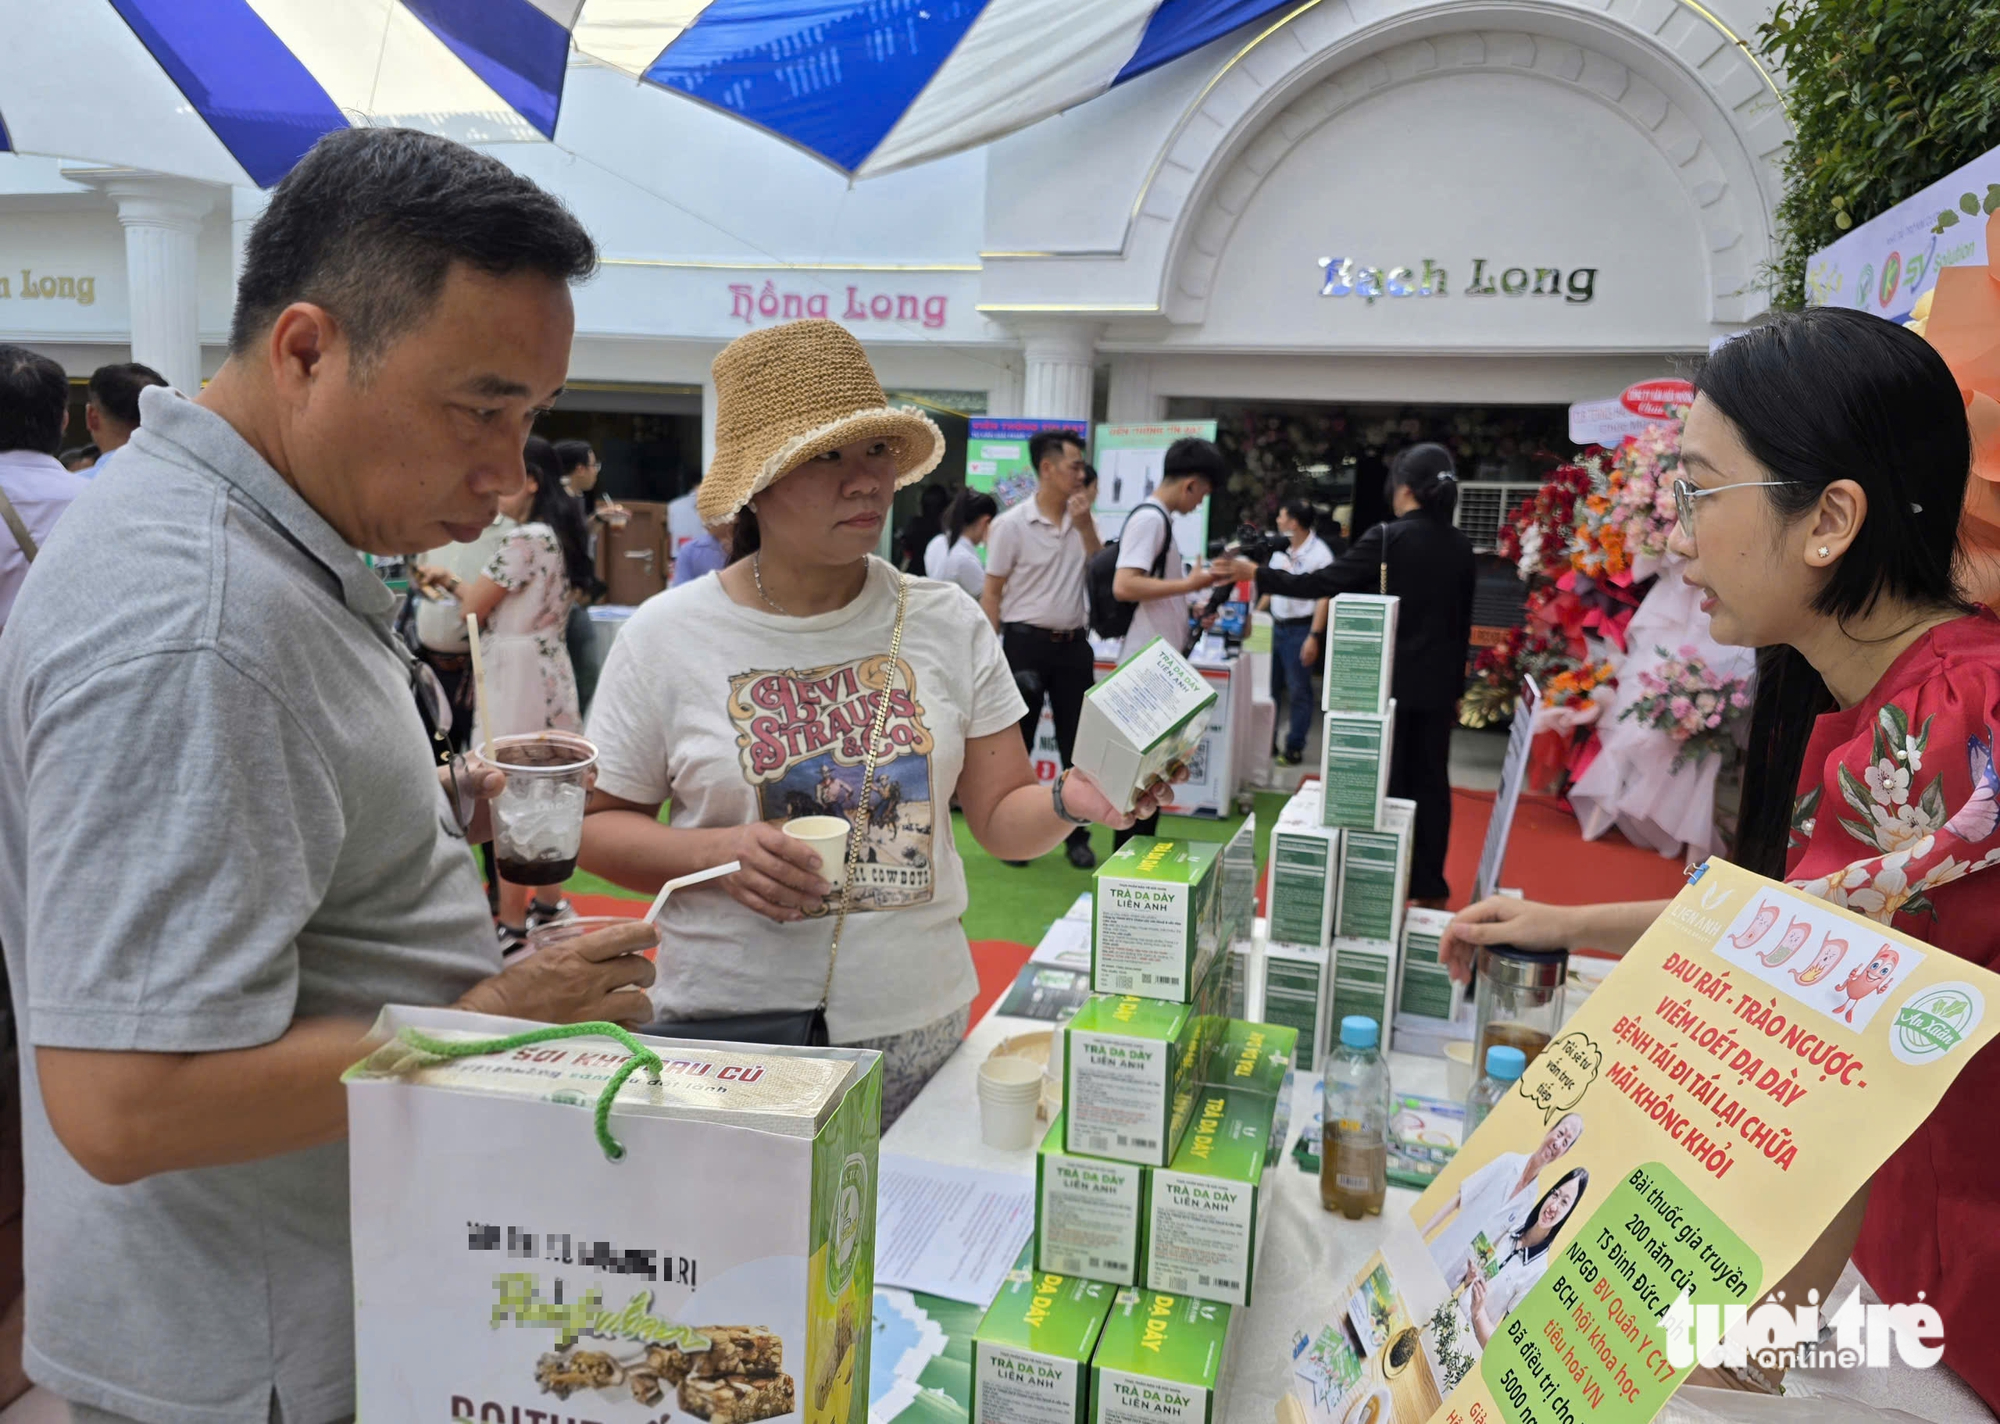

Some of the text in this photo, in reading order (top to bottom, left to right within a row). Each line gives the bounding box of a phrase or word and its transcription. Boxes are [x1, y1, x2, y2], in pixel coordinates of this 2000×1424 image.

[20, 269, 95, 306] Long
[1464, 259, 1598, 304] Long
[843, 286, 948, 328] Long
[751, 667, 859, 727] LEVI
[1173, 677, 1190, 693] ANH
[750, 688, 916, 774] STRAUSS
[841, 736, 861, 757] &
[1110, 887, 1132, 899] TRÀ
[1153, 890, 1175, 903] DÀY
[1117, 899, 1168, 912] LIÊN ANH
[1662, 952, 1702, 983] ĐAU
[1693, 971, 1732, 1002] RÁT
[1732, 994, 1787, 1037] TRÀO
[1779, 1024, 1864, 1086] NGƯỢC
[1901, 1013, 1955, 1045] An Xuân
[1083, 1042, 1107, 1058] TRÀ
[1129, 1047, 1153, 1061] DÀY
[1120, 1058, 1145, 1070] ANH
[1562, 1040, 1578, 1057] Tôi
[1655, 996, 1699, 1034] VIÊM
[1728, 1048, 1764, 1086] DẠ
[1755, 1067, 1807, 1108] DÀY
[716, 1064, 766, 1083] CỦ
[1611, 1015, 1798, 1172] BỆNH TÁI ĐI TÁI LẠI CHỮA
[1605, 1061, 1735, 1180] MÃI KHÔNG KHỎI
[1190, 1134, 1215, 1159] DÀY
[1057, 1166, 1080, 1183] TRÀ
[1102, 1171, 1125, 1186] DÀY
[1093, 1181, 1117, 1195] ANH
[1166, 1182, 1189, 1199] TRÀ
[1213, 1189, 1238, 1204] DÀY
[1202, 1199, 1229, 1212] ANH
[1628, 1169, 1748, 1298] Bài thuốc gia truyền
[1596, 1227, 1614, 1250] TS
[1607, 1243, 1637, 1282] Đinh
[1631, 1273, 1660, 1311] Đức
[1625, 1213, 1697, 1298] 200 năm của
[1035, 1273, 1063, 1295] DẠ
[1023, 1296, 1052, 1328] DÀY
[1147, 1294, 1174, 1318] DẠ
[1565, 1241, 1676, 1383] NPGĐ BV Quân Y C17
[1141, 1318, 1168, 1353] DÀY
[1552, 1275, 1640, 1404] BCH hội khoa học
[991, 1356, 1014, 1370] TRÀ
[1038, 1365, 1062, 1380] DÀY
[1507, 1319, 1575, 1424] Đã điều trị cho
[1543, 1318, 1605, 1410] tiêu hoá VN
[1028, 1375, 1054, 1389] ANH
[1114, 1382, 1138, 1398] TRÀ
[1164, 1389, 1191, 1407] DÀY
[1500, 1368, 1527, 1409] 5000
[1153, 1400, 1182, 1417] ANH
